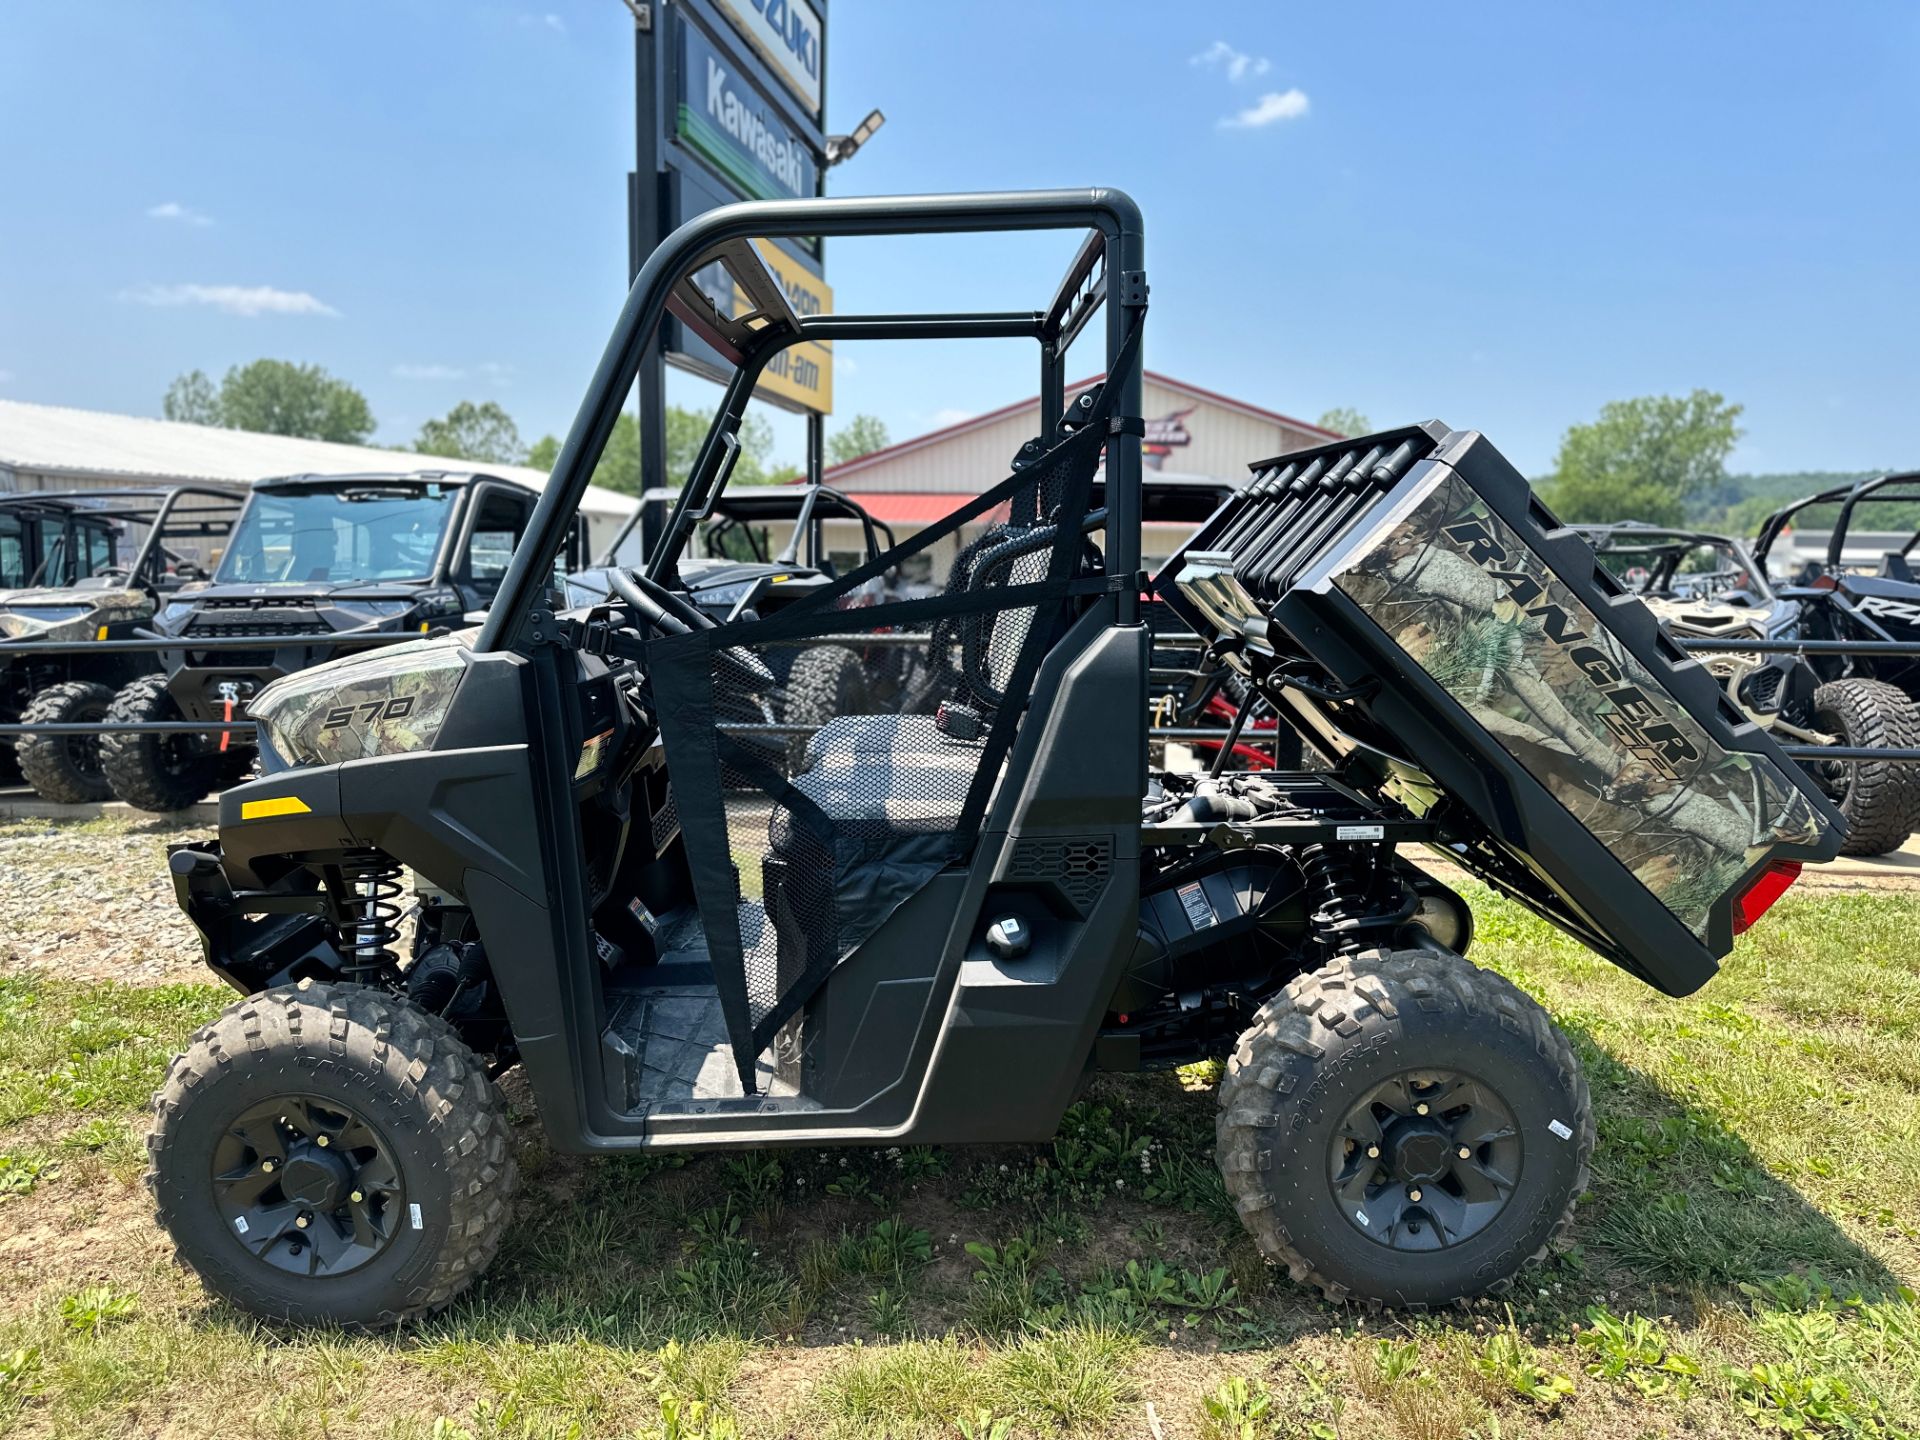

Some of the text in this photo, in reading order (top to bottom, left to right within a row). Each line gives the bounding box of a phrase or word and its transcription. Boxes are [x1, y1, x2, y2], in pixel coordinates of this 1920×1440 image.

[750, 0, 817, 81] ZUKI
[707, 56, 803, 197] Kawasaki
[766, 347, 819, 392] an-am
[423, 595, 455, 607] XP
[1441, 520, 1700, 766] RANGER
[323, 695, 416, 730] 570
[1595, 713, 1682, 781] SP
[1290, 1031, 1388, 1132] CARLISLE
